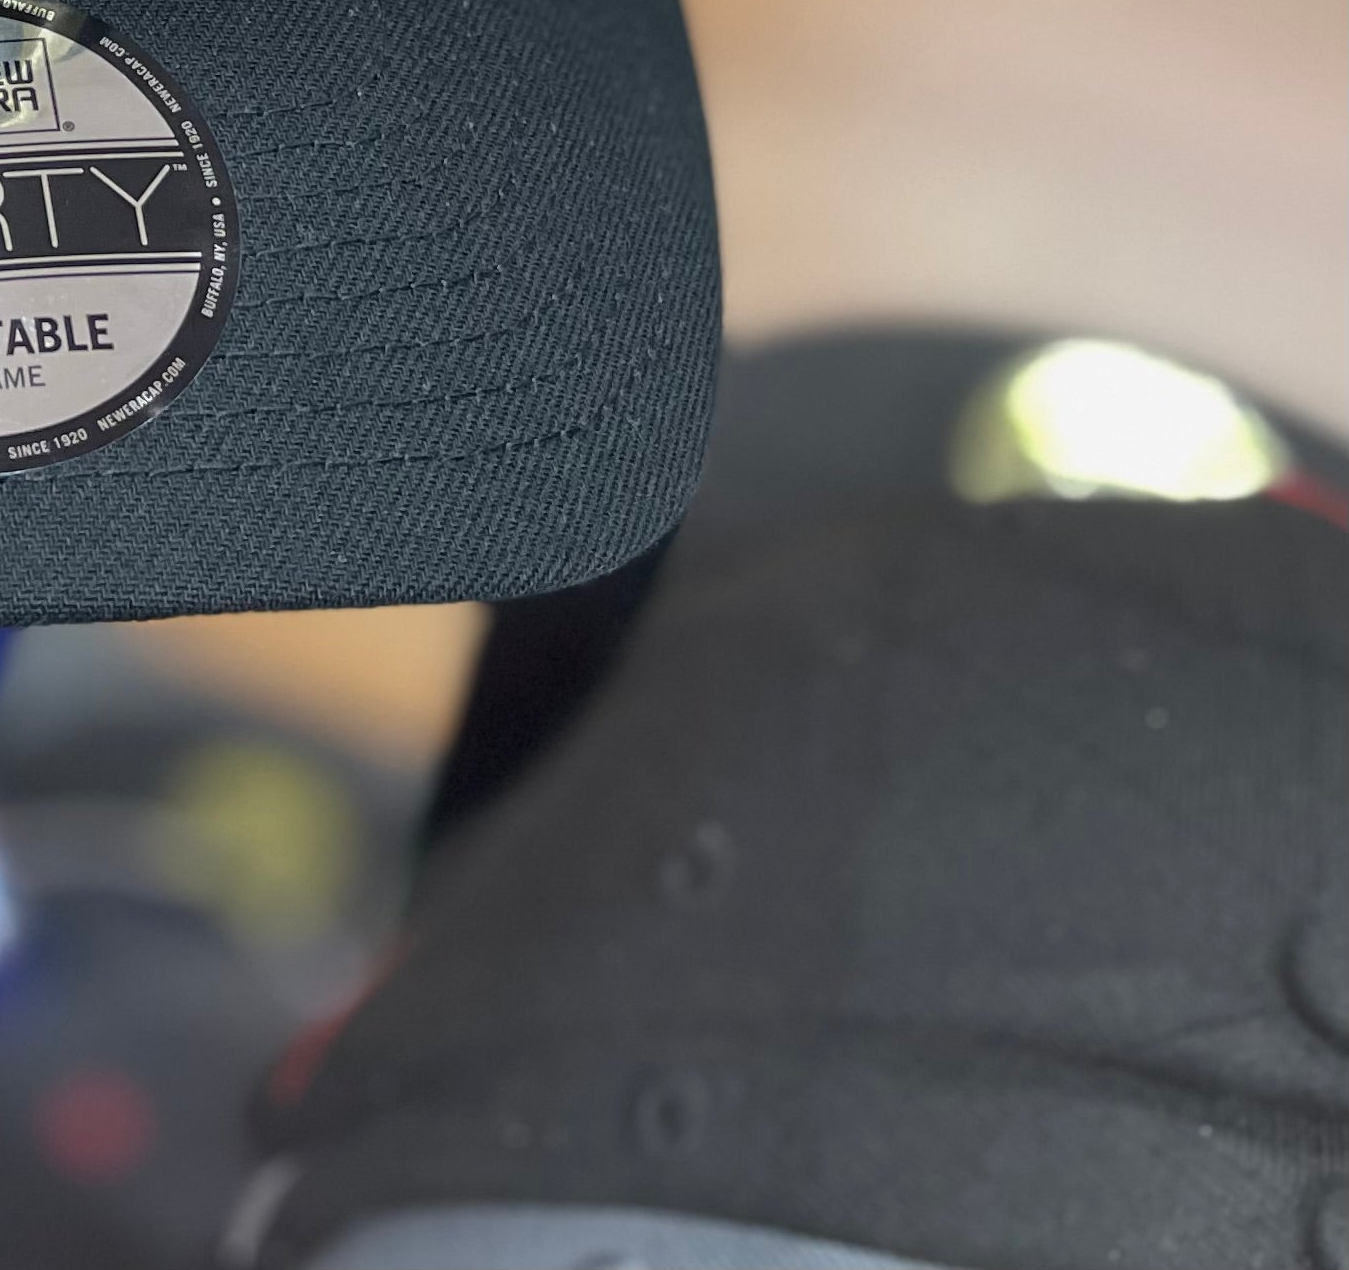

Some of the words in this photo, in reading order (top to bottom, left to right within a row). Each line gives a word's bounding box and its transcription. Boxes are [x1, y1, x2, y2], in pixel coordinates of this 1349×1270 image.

[99, 35, 182, 113] NEWERACAP.COM
[180, 120, 205, 151] 1920
[196, 152, 218, 189] SINCE
[213, 212, 227, 238] USA
[7, 440, 51, 461] SINCE
[53, 427, 89, 450] 1920
[96, 356, 187, 433] NEWERACAP.COM
